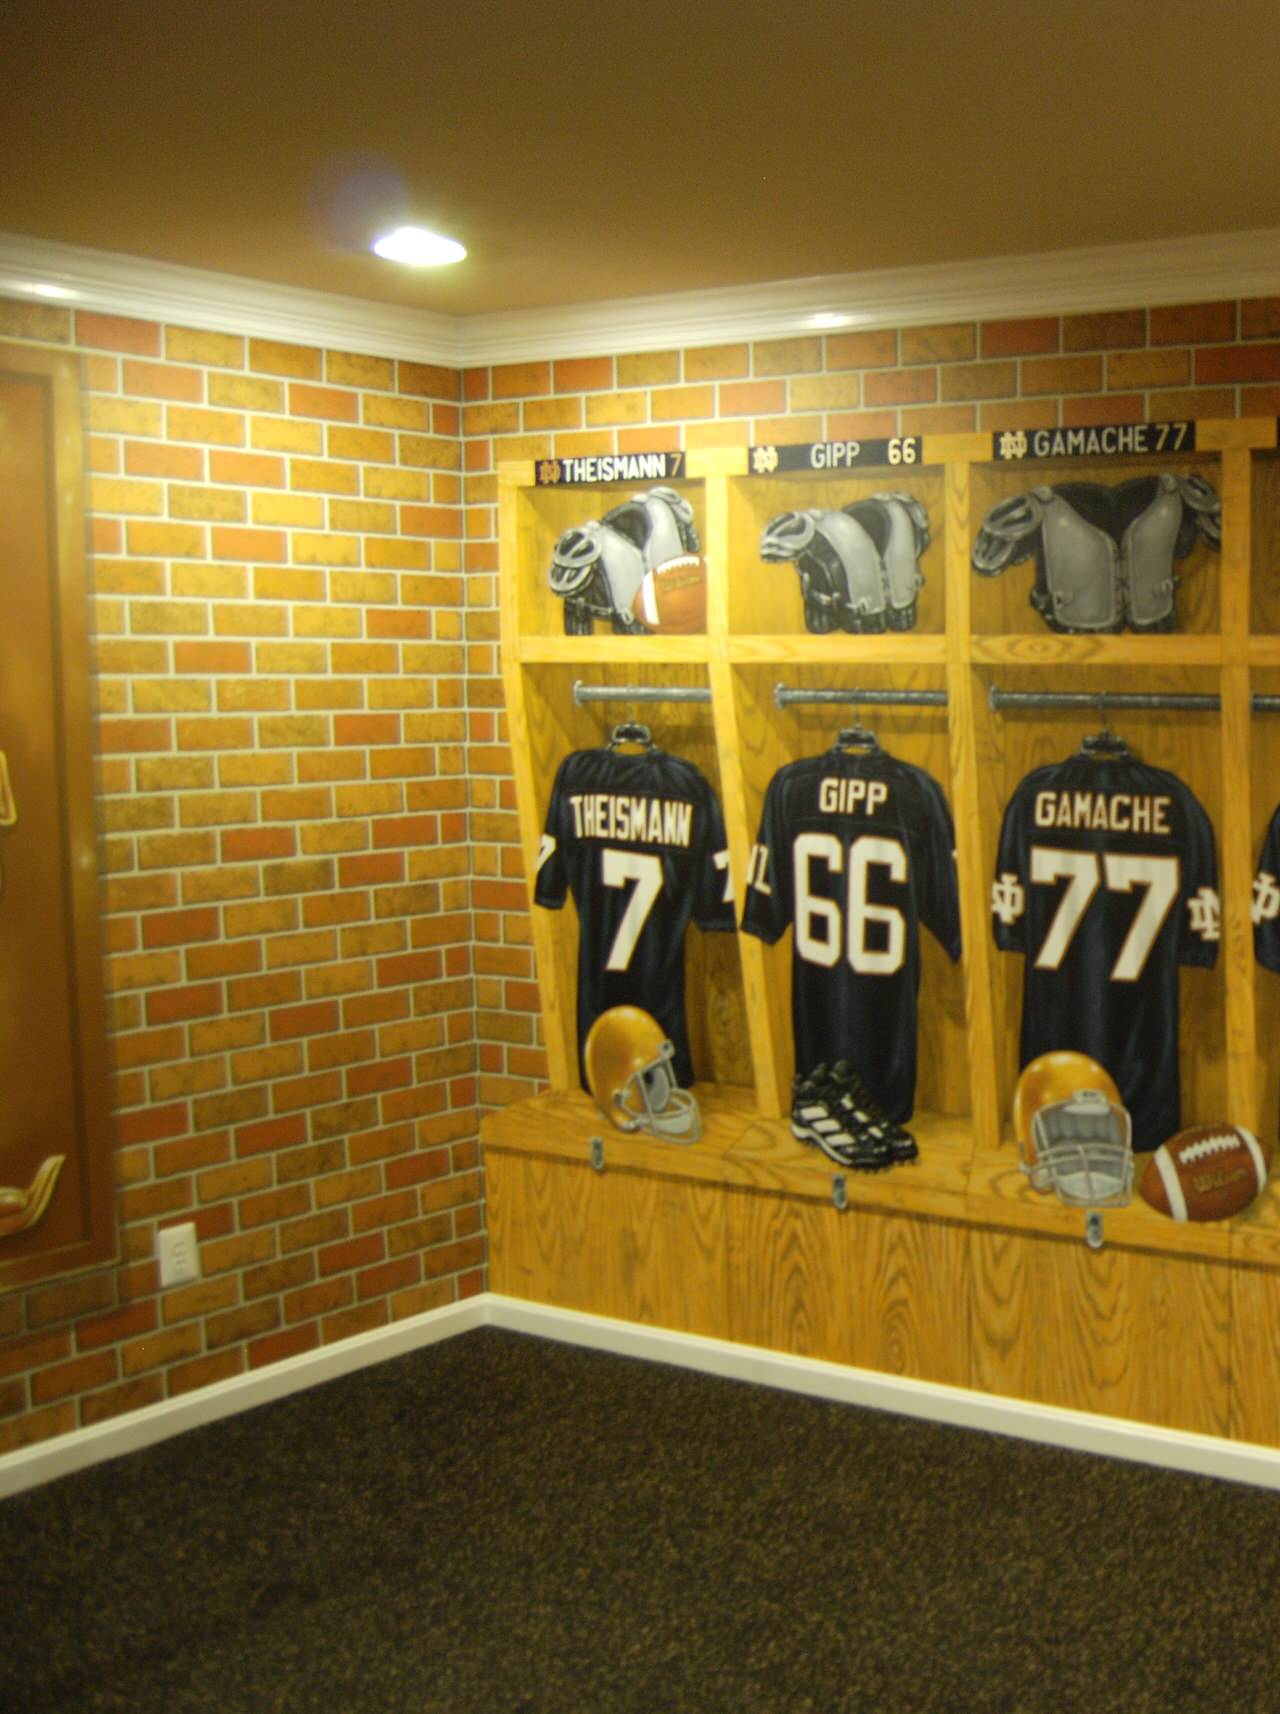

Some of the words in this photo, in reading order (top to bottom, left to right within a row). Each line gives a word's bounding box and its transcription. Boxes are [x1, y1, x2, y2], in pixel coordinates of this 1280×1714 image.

[810, 441, 860, 468] GIPP
[887, 437, 916, 465] 66
[1033, 425, 1149, 457] GAMACHE
[1155, 423, 1187, 451] 77
[563, 454, 665, 482] THEISMANN
[670, 453, 682, 477] 7
[819, 776, 888, 816] GIPP
[1034, 791, 1172, 835] GAMACHE
[569, 793, 693, 848] THEISMANN
[602, 848, 664, 972] 7
[793, 832, 908, 976] 66
[1029, 845, 1181, 983] 77
